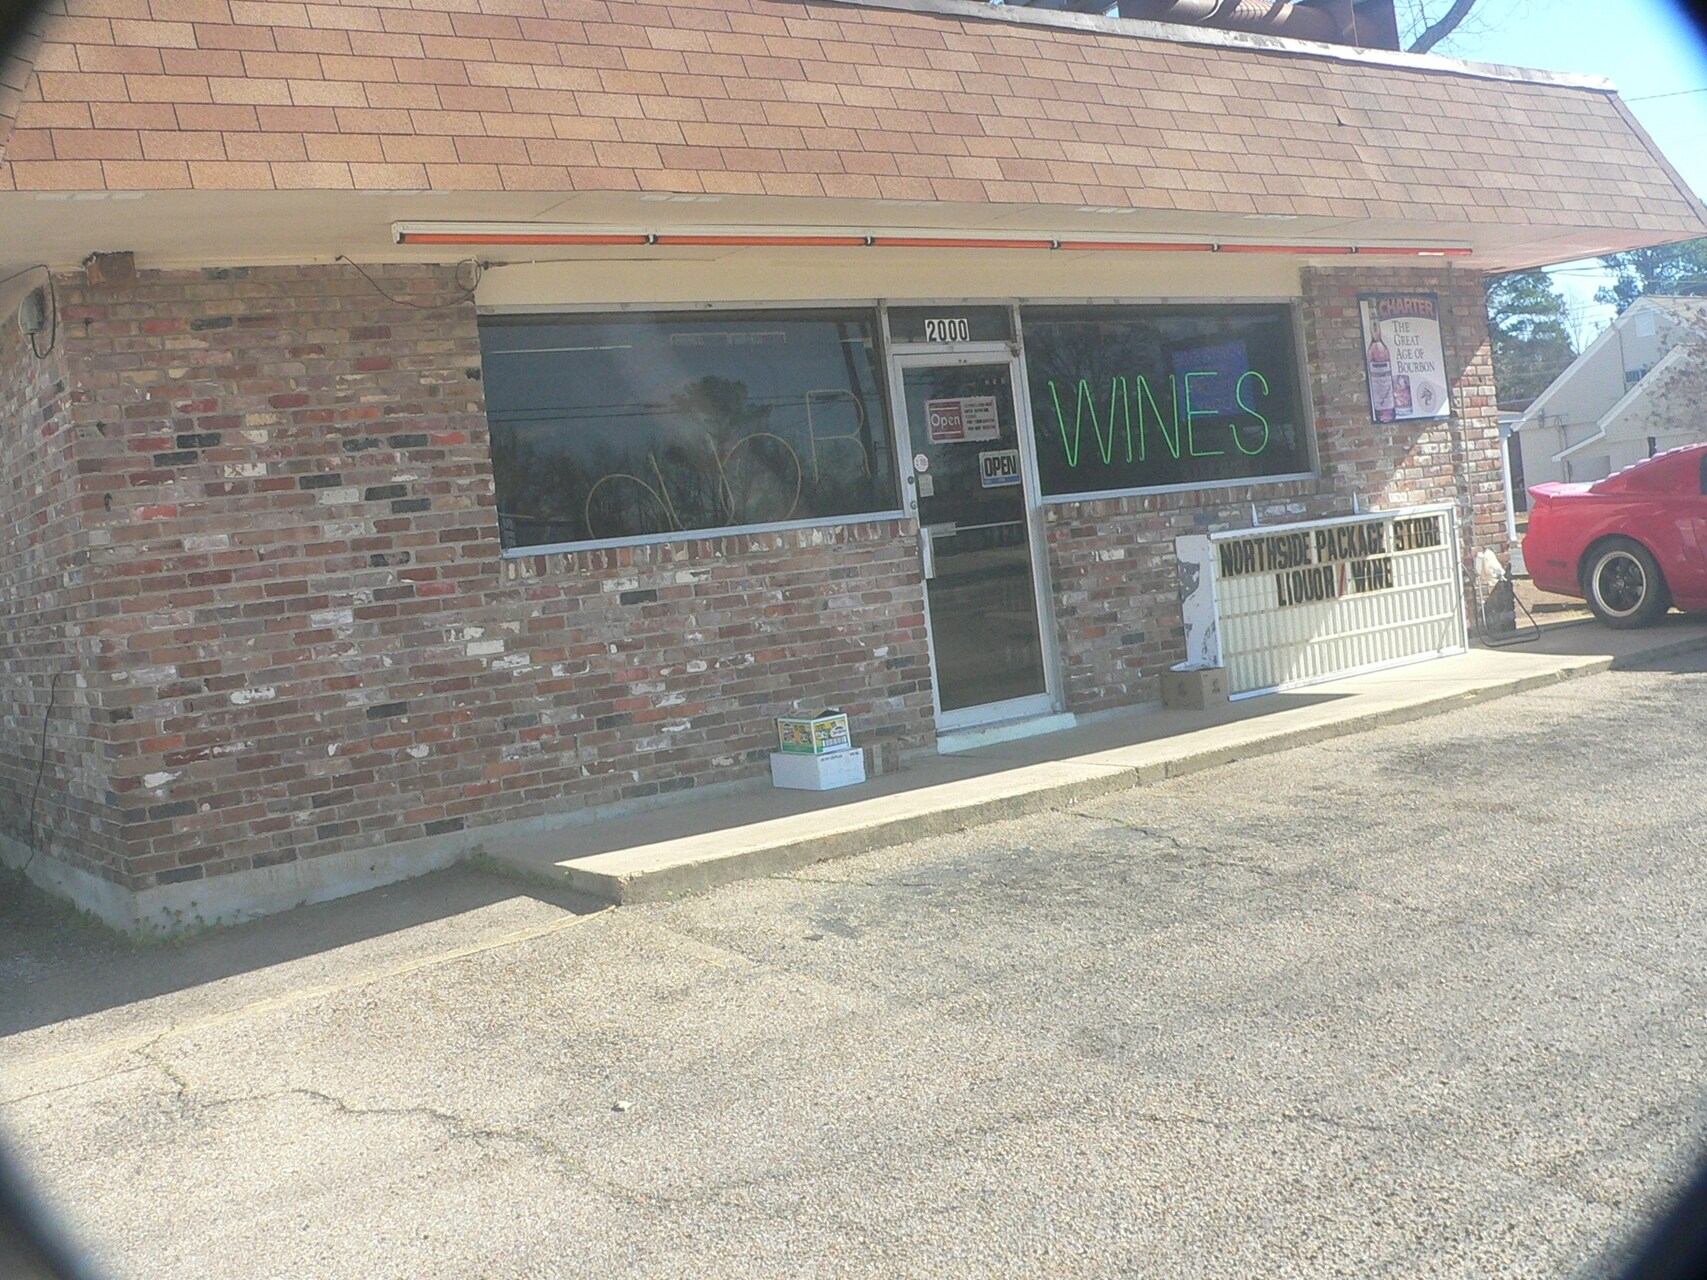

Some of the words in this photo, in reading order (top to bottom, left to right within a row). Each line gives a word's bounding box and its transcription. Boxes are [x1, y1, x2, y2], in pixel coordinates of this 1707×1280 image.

[1378, 297, 1434, 318] CHARTER
[927, 320, 968, 342] 2000
[1392, 320, 1410, 333] THE
[1393, 334, 1420, 346] GREAT
[1396, 348, 1413, 360] AGE
[1414, 349, 1425, 359] OF
[1397, 361, 1435, 373] BOURBON
[931, 413, 961, 430] Open
[1048, 371, 1269, 467] WINES
[984, 456, 1016, 477] OPEN
[1219, 531, 1311, 577] NORTHSIDE
[1315, 522, 1384, 563] PACKAGE
[1393, 515, 1440, 551] STORE
[1351, 557, 1392, 593] WINE
